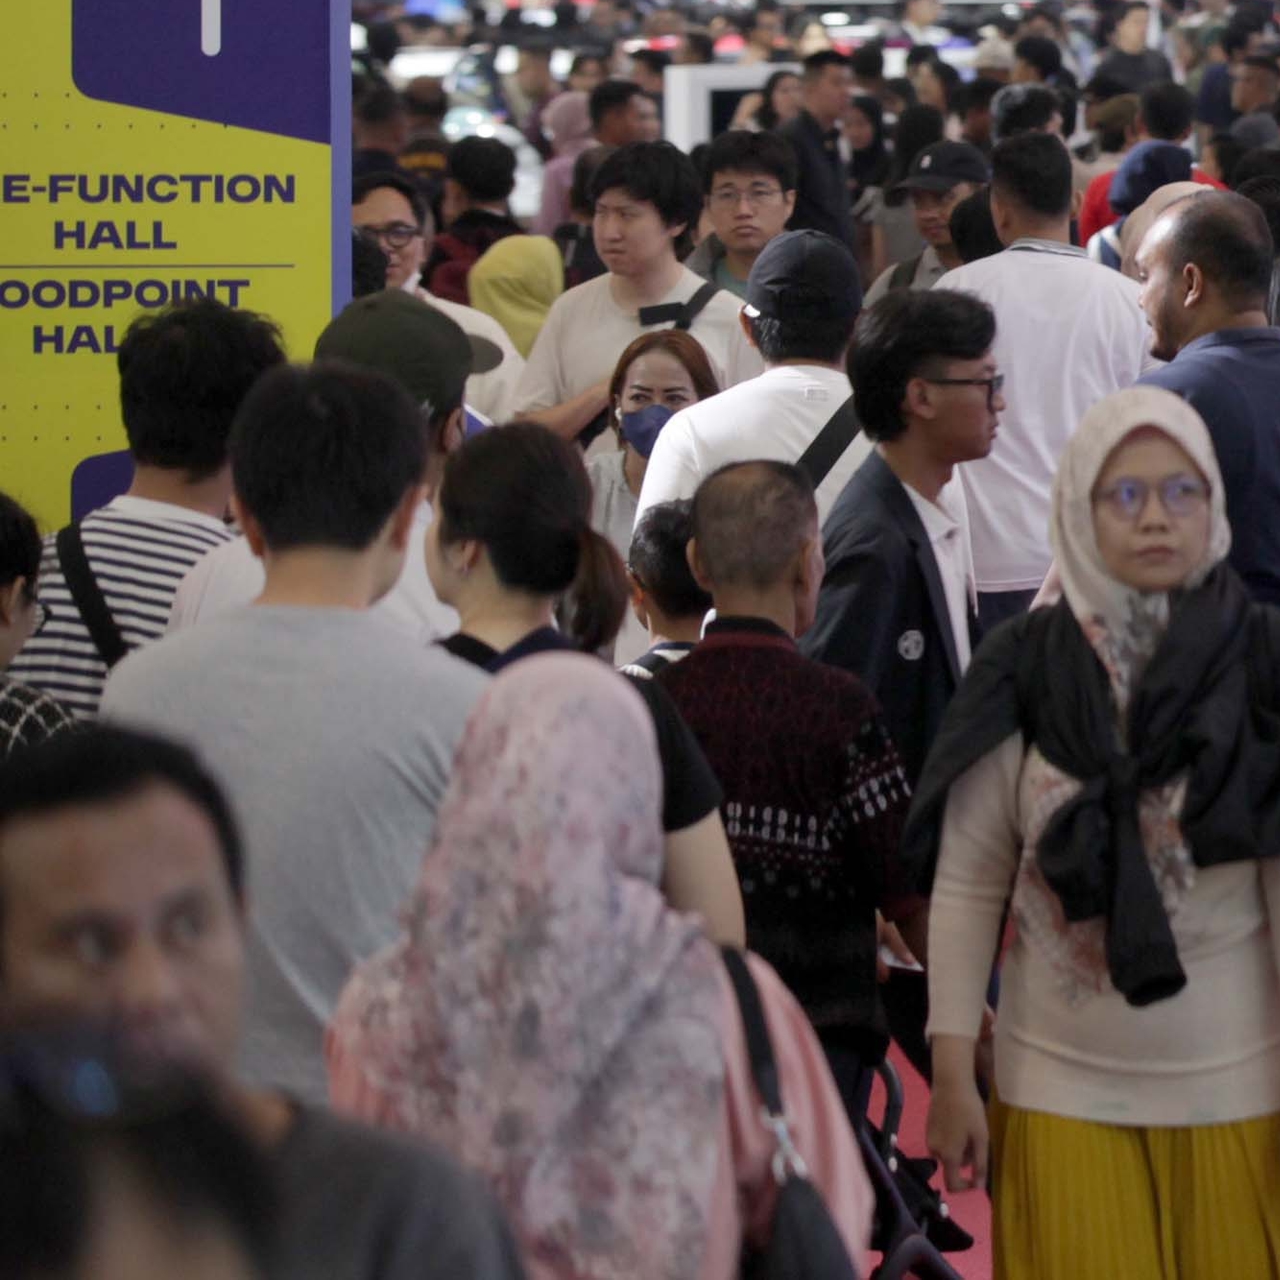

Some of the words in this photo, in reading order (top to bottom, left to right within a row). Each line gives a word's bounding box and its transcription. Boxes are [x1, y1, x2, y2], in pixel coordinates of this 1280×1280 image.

[3, 175, 295, 203] E-FUNCTION
[54, 221, 177, 249] HALL
[33, 325, 121, 354] HAL
